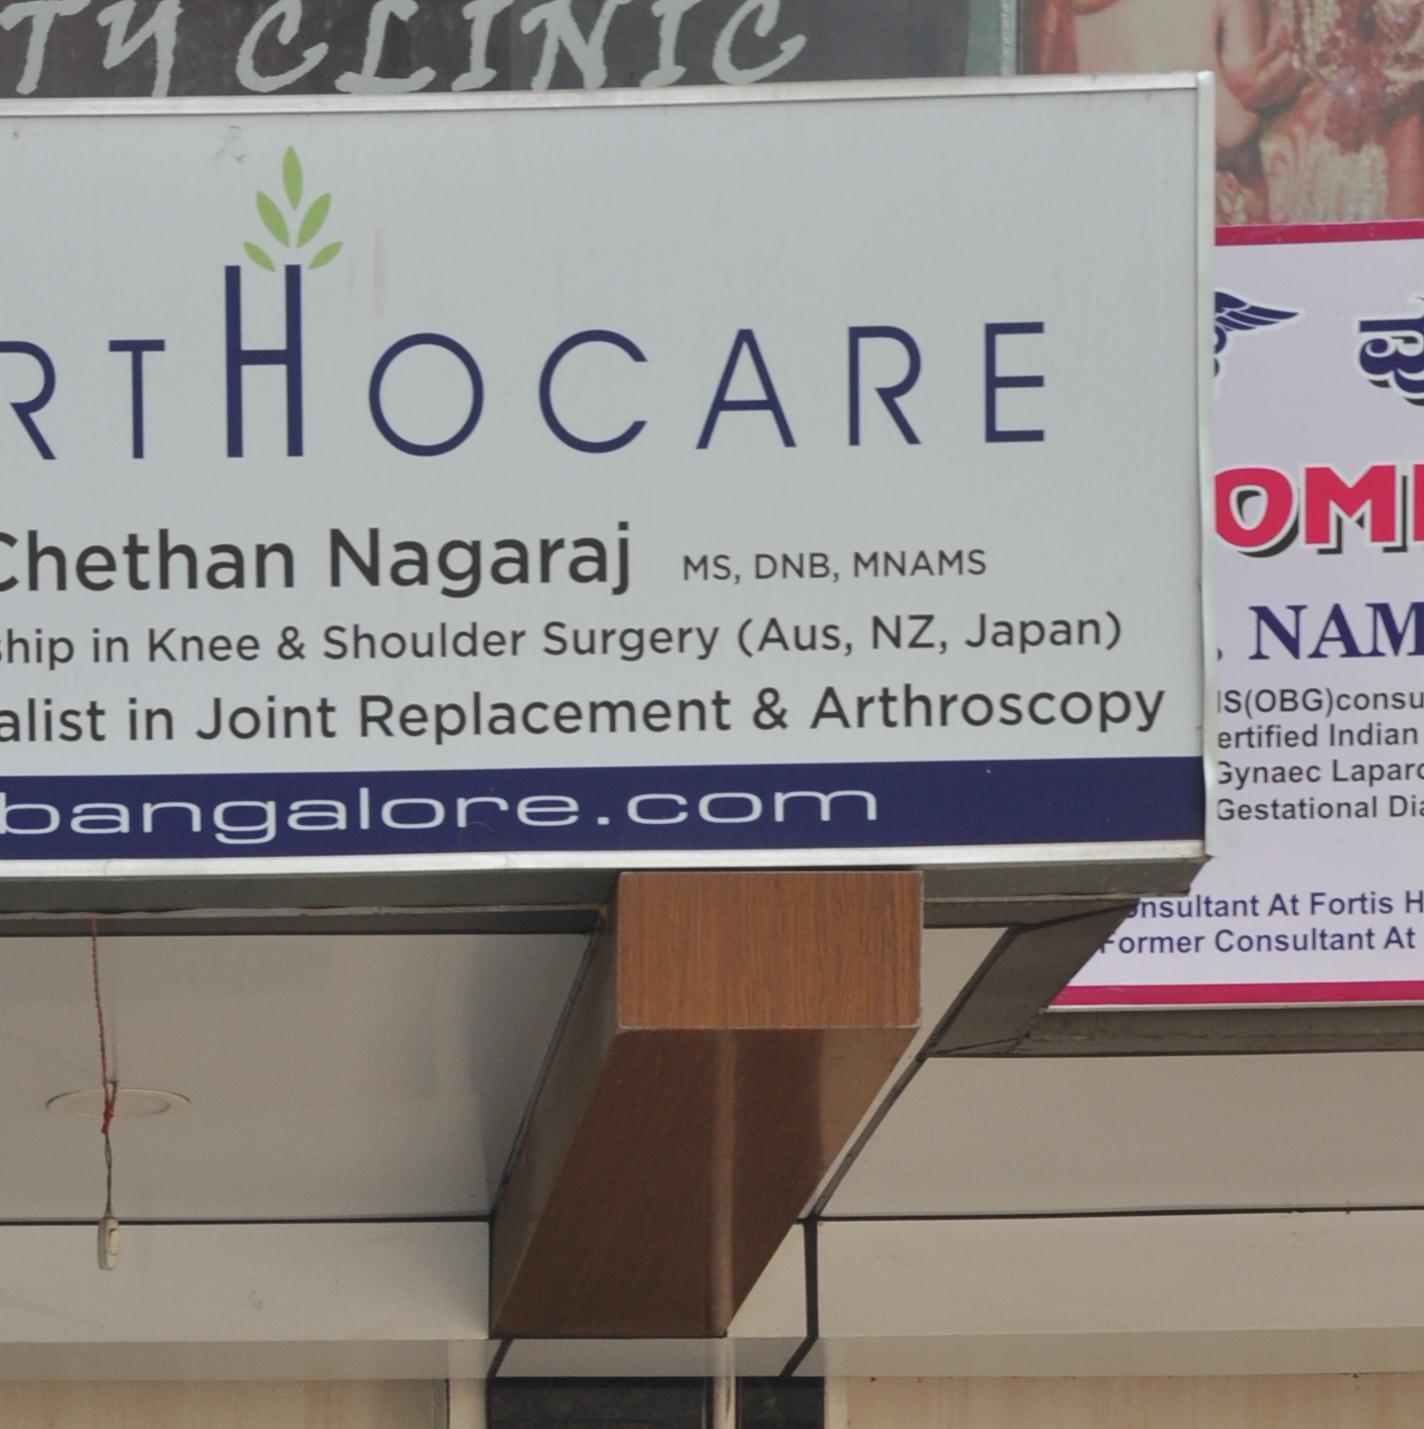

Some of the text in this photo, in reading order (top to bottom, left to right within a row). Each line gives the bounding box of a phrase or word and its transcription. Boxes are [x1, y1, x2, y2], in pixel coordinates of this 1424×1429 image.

[235, 0, 806, 93] CLINIC
[329, 521, 631, 598] Nagaraj
[682, 554, 741, 583] MS,
[754, 551, 840, 583] DNB,
[852, 549, 987, 578] MNAMS
[92, 627, 130, 663] in
[148, 628, 261, 662] Knee
[277, 625, 307, 661] &
[322, 621, 526, 660] Shoulder
[542, 620, 720, 662] Surgery
[737, 616, 853, 658] (Aus,
[871, 614, 948, 653] NZ,
[965, 610, 1122, 654] Japan)
[128, 696, 174, 742] in
[195, 694, 337, 740] Joint
[358, 689, 732, 745] Replacement
[752, 687, 789, 730] &
[810, 683, 1165, 732] Arthroscopy
[1329, 722, 1419, 747] Indian
[1217, 795, 1377, 820] Gestational
[1267, 893, 1300, 917] At
[1310, 890, 1394, 915] Fortis
[1214, 927, 1375, 951] Consultant
[1383, 926, 1416, 949] At
